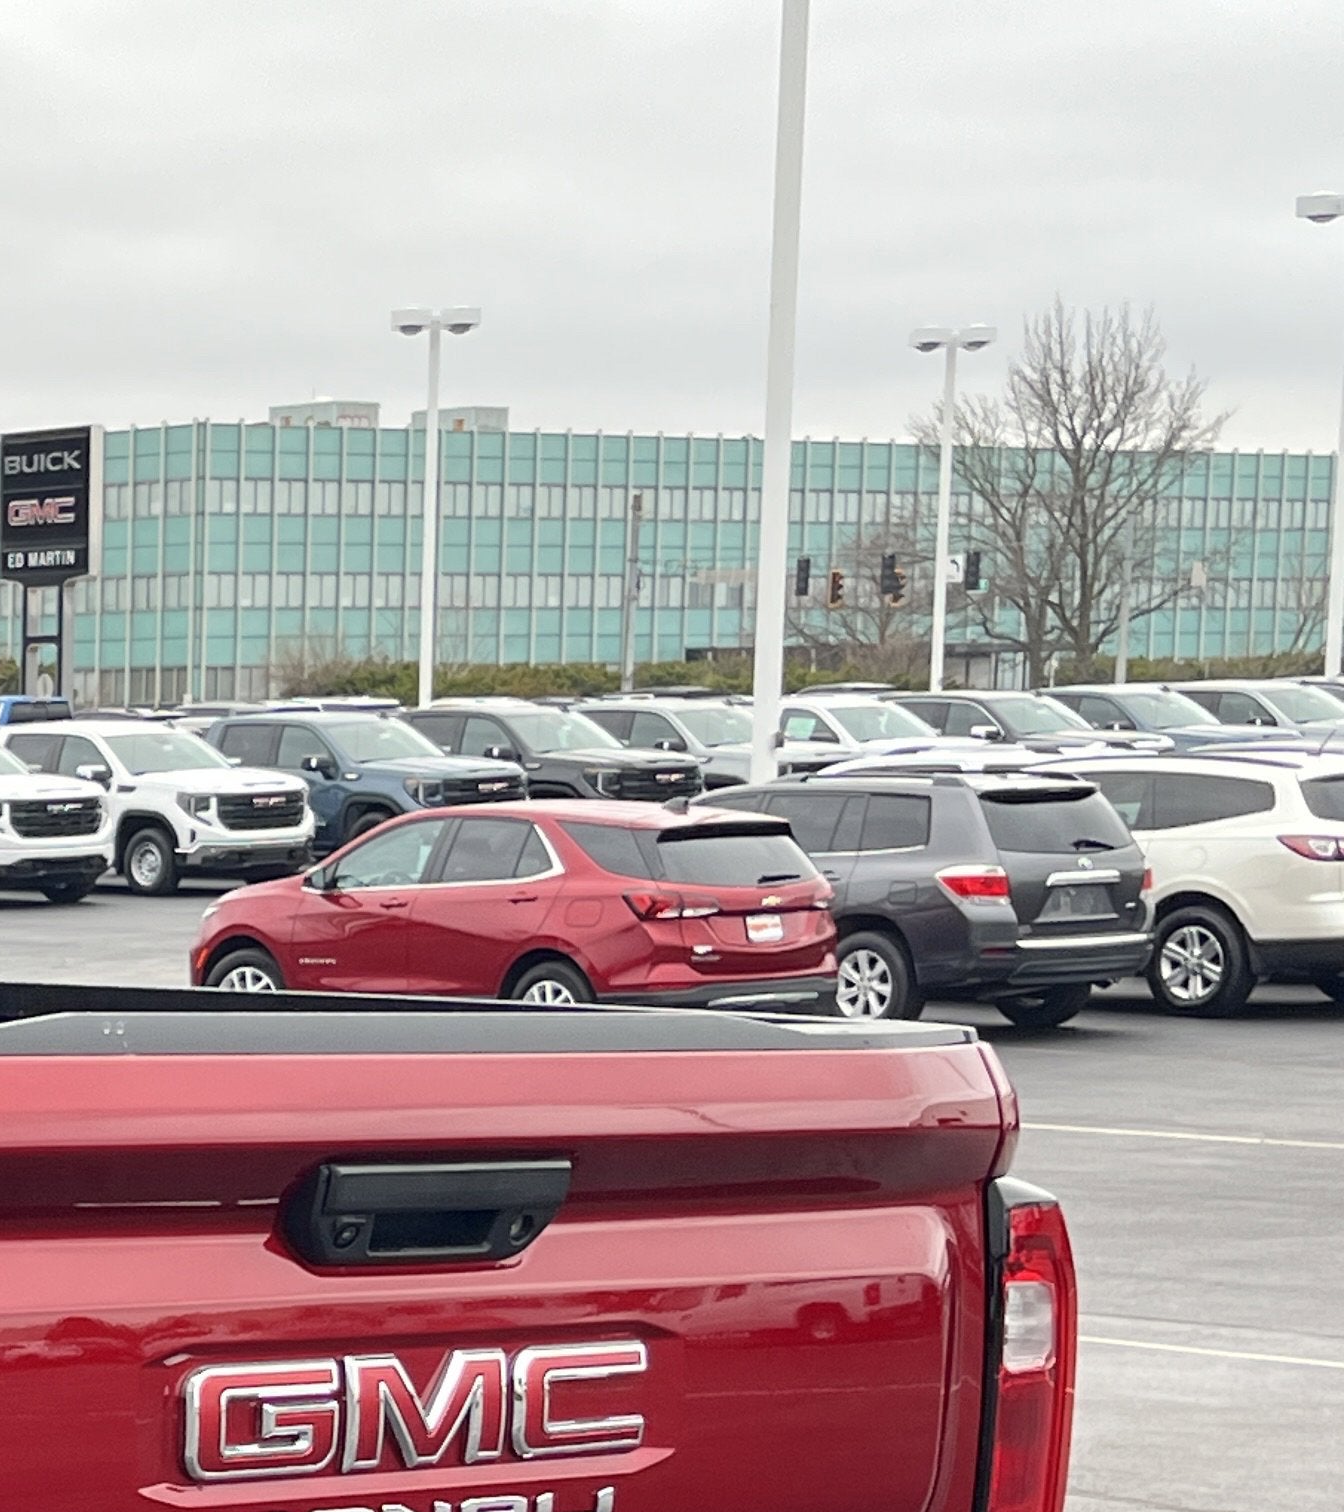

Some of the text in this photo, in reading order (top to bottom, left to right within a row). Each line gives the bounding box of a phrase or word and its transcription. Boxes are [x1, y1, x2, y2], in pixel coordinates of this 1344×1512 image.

[4, 450, 81, 475] BUICK
[7, 496, 75, 526] GMC
[7, 550, 75, 568] ED MARTIN
[182, 1340, 648, 1481] GMC
